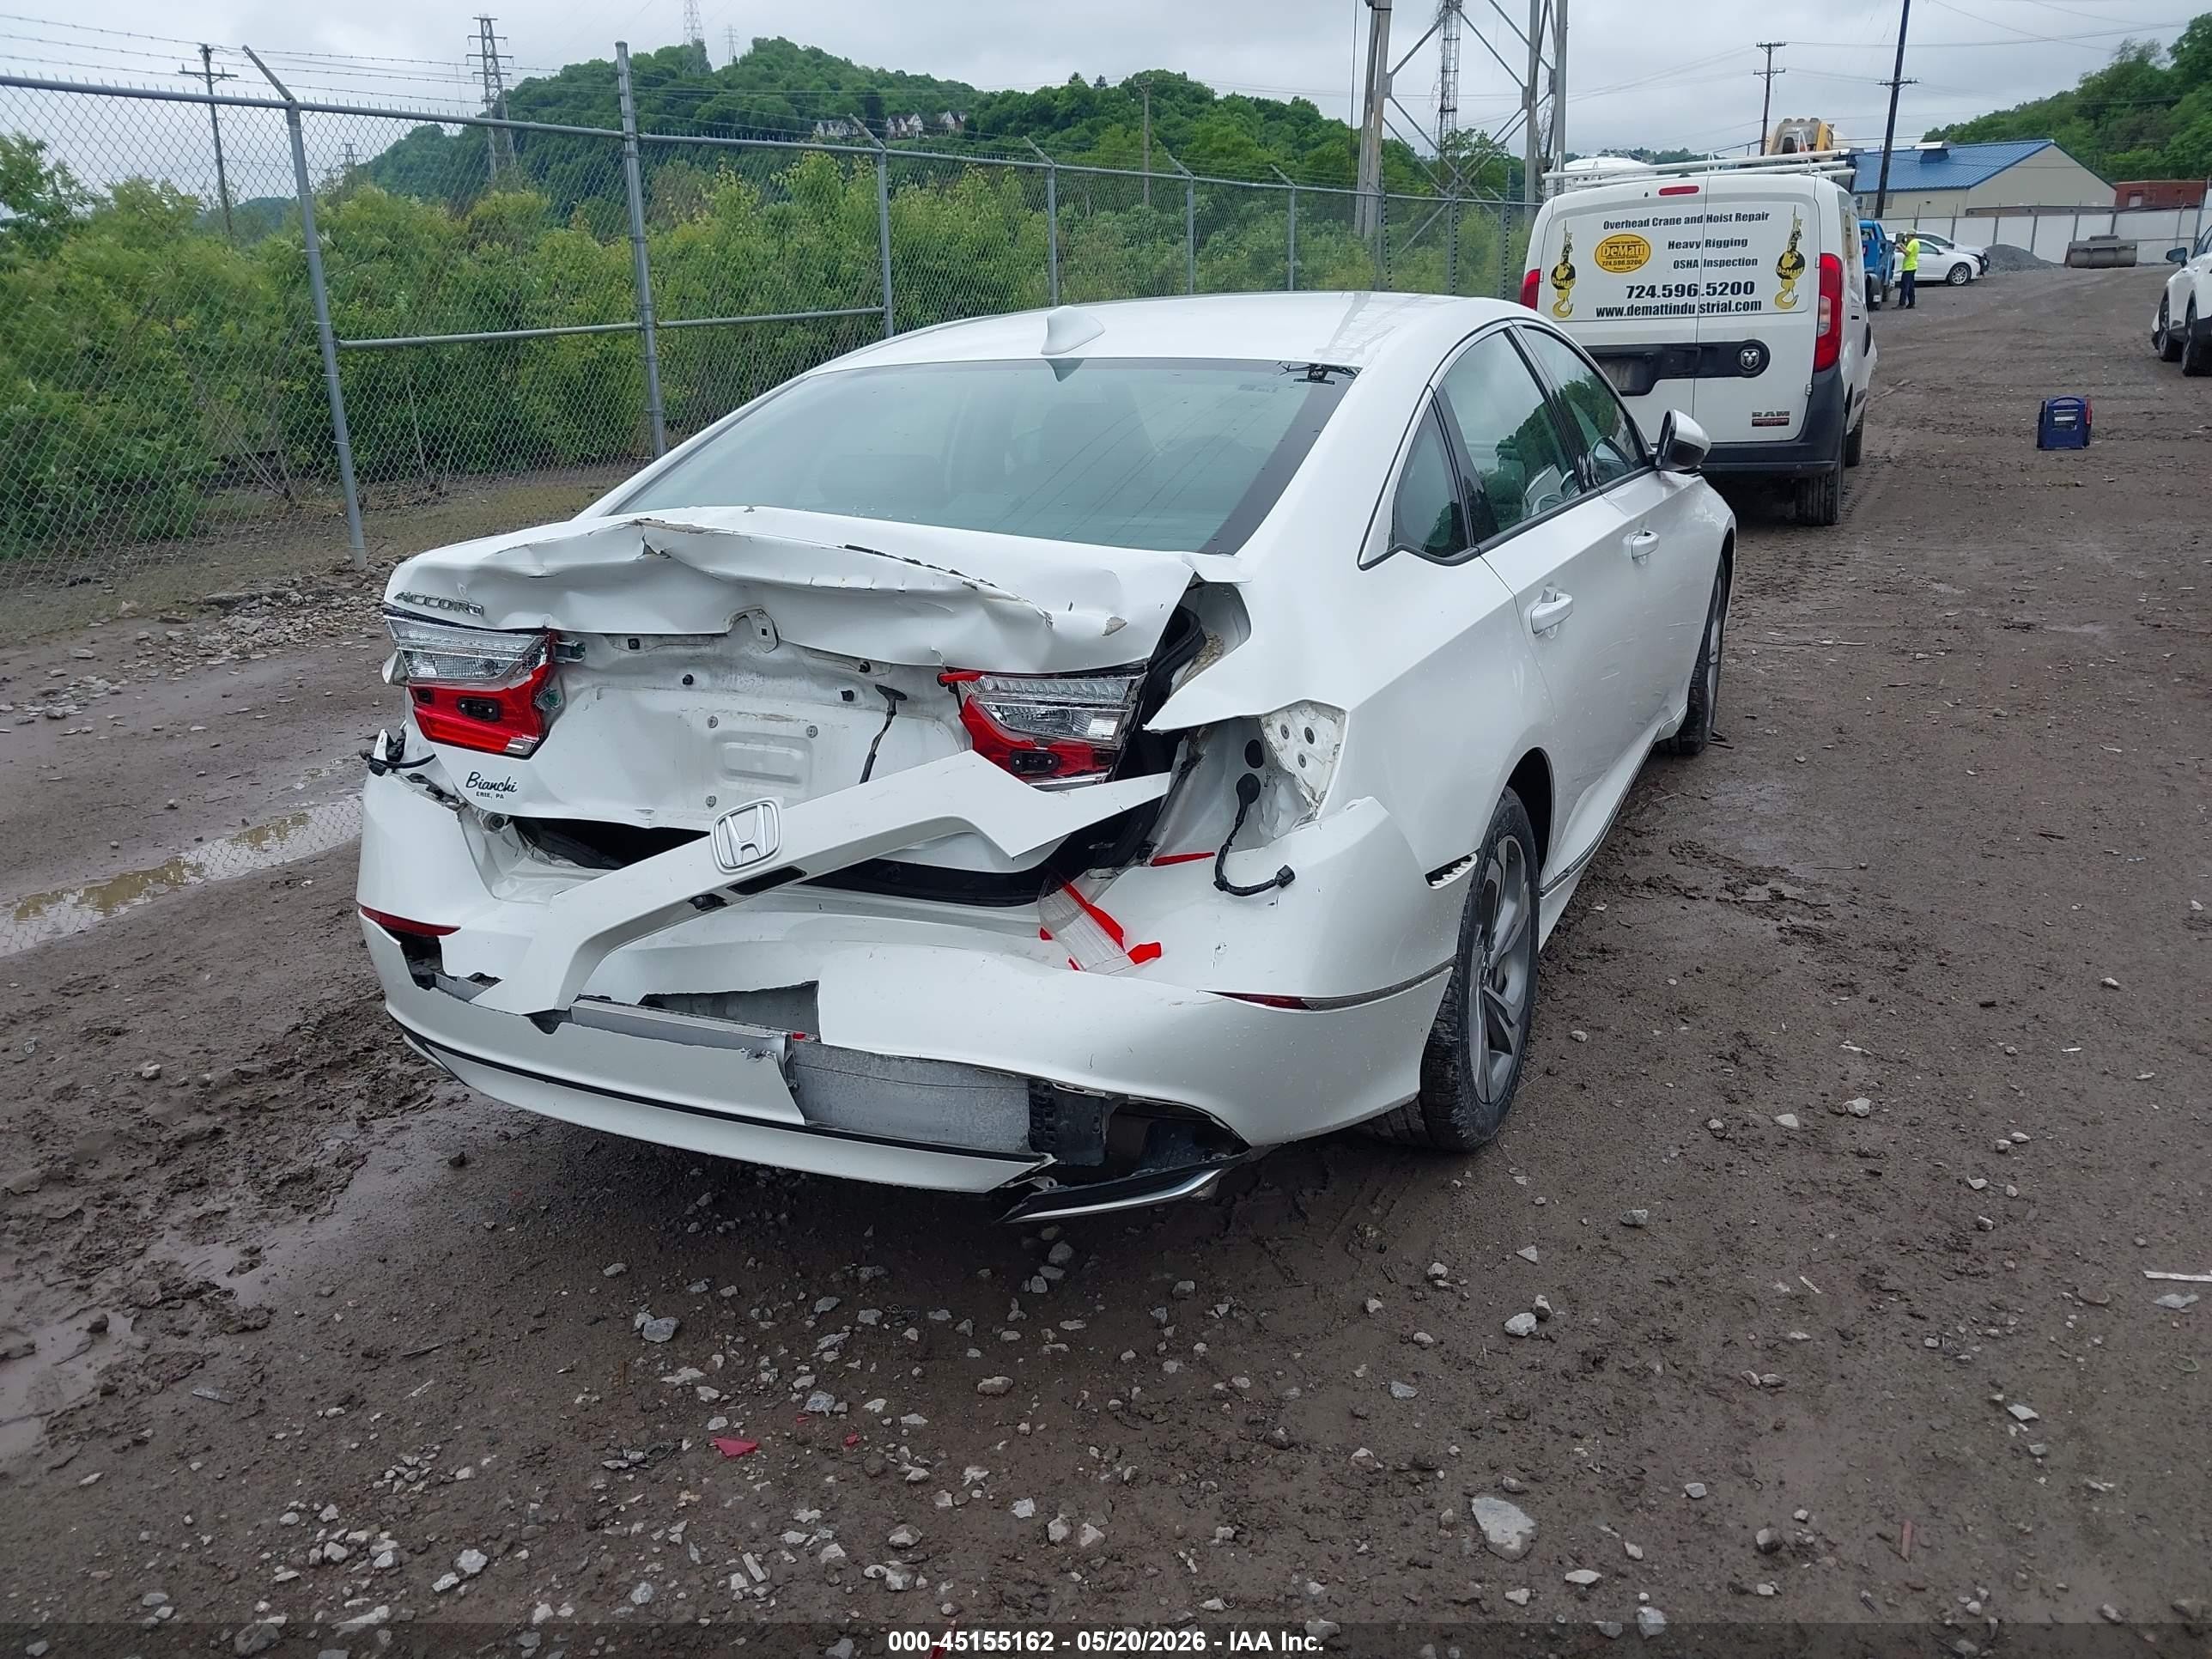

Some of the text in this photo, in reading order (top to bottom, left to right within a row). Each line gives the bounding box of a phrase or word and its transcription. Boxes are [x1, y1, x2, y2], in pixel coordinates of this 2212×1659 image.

[1603, 211, 1770, 229] Overhead Crane and Hoist Repair
[1668, 238, 1748, 250] Heavy Rigging
[1673, 258, 1758, 269] OSHA Inspection
[1626, 281, 1755, 299] 724.596.5200
[393, 591, 484, 616] ACCORD
[465, 771, 518, 793] Bianchi
[476, 791, 492, 800] ERIE,
